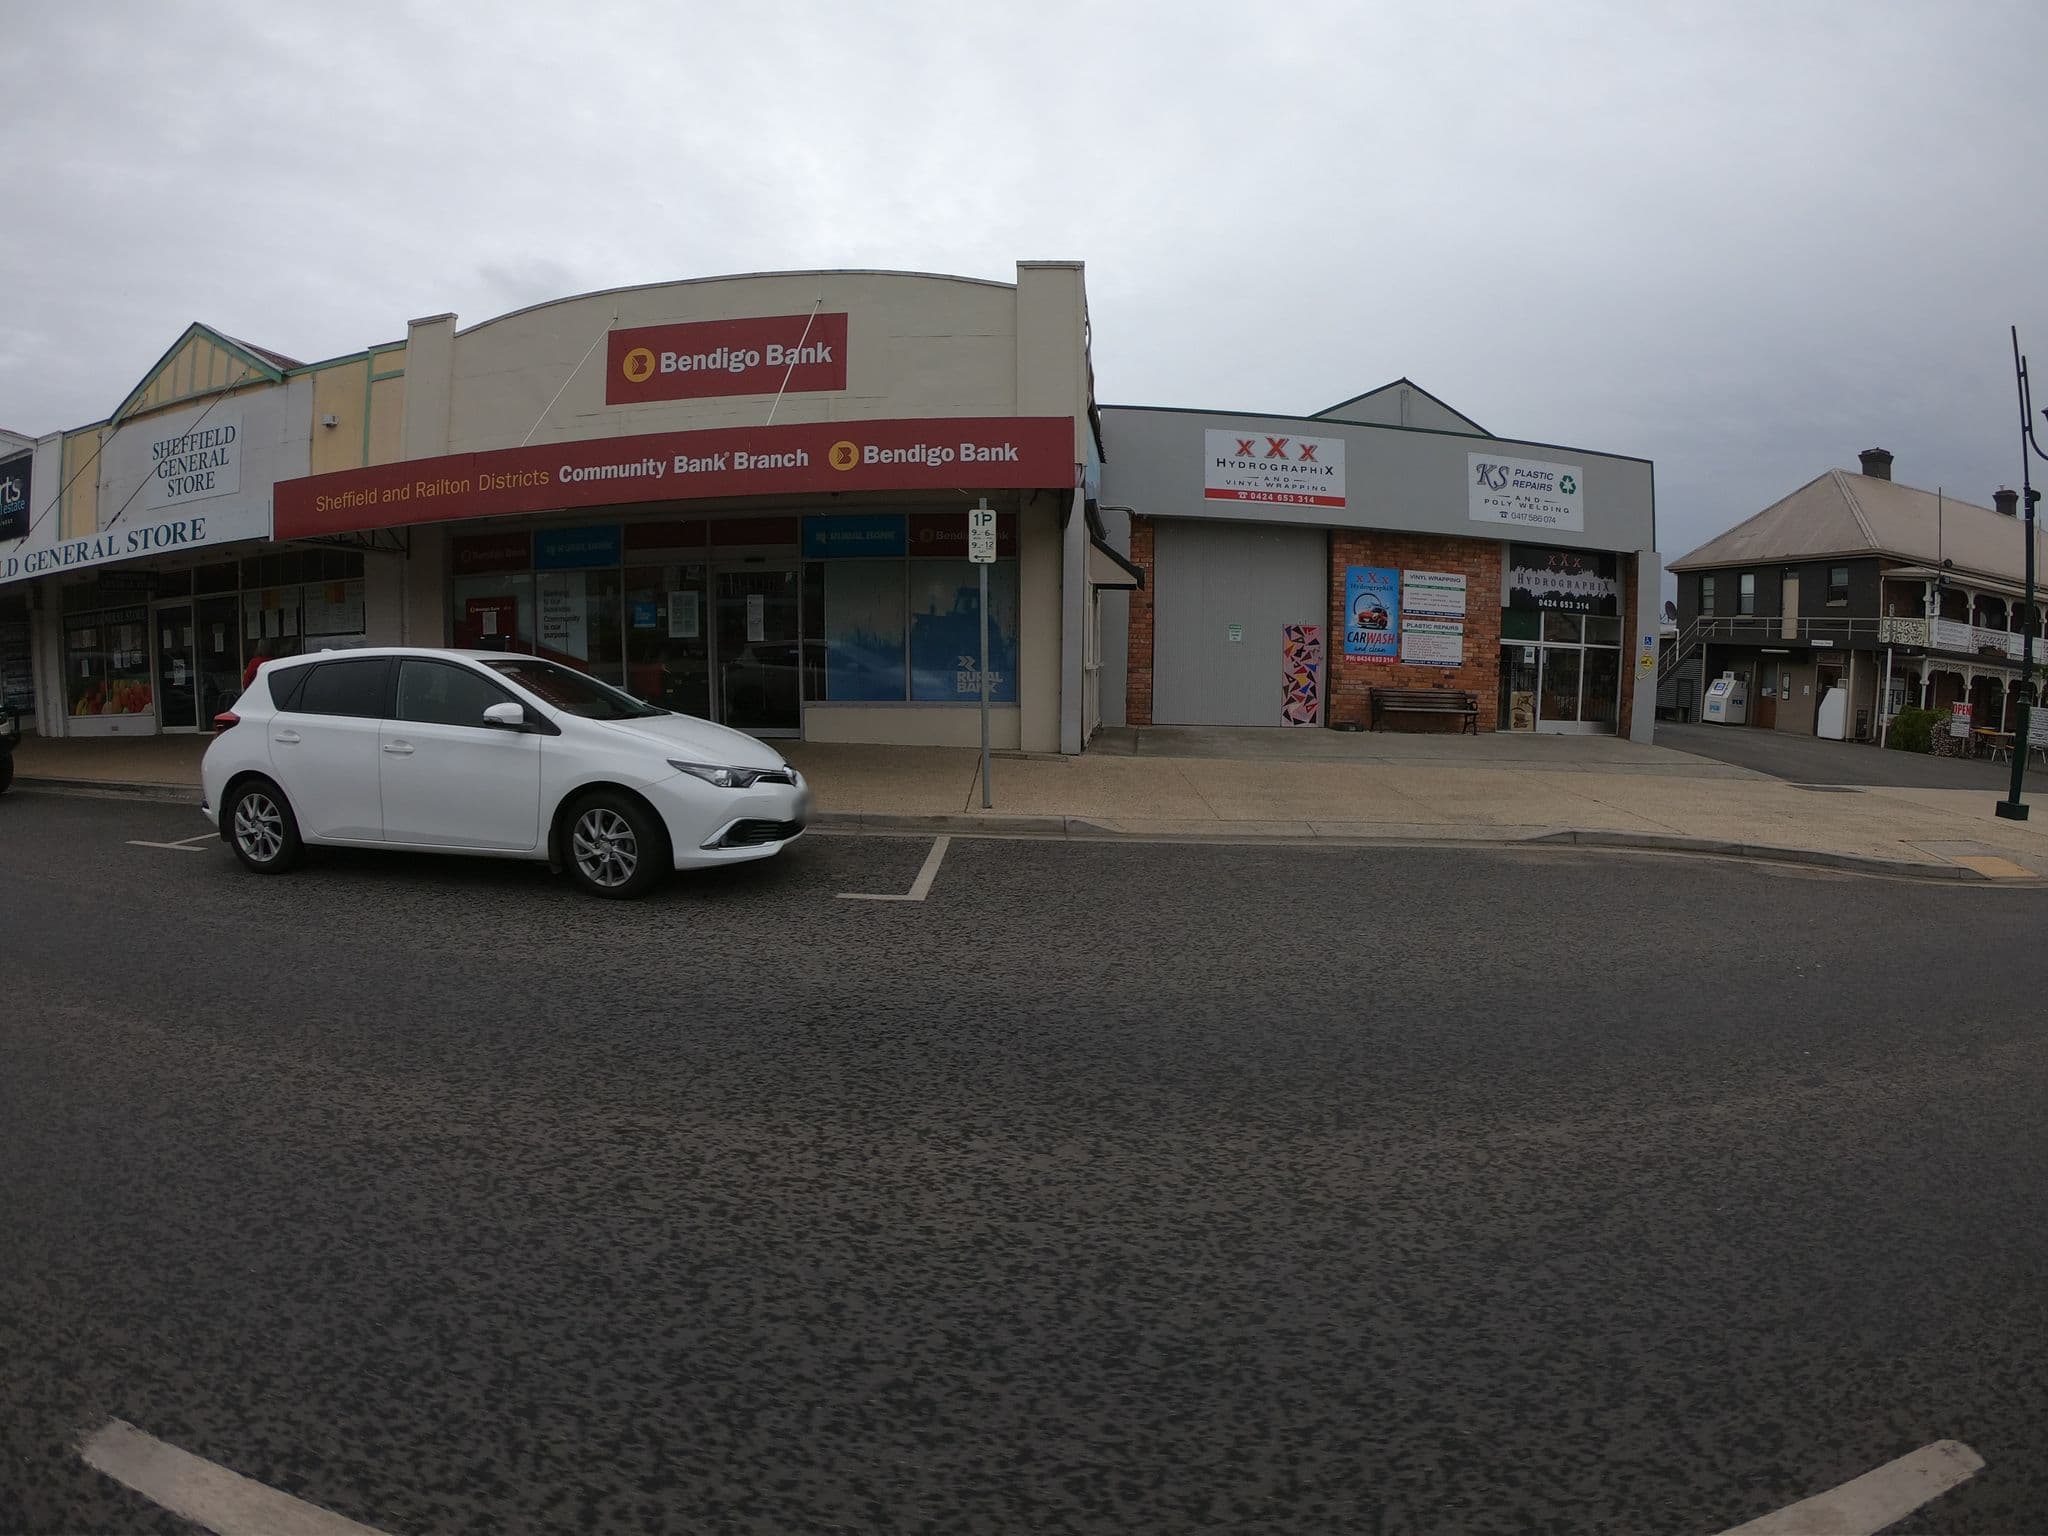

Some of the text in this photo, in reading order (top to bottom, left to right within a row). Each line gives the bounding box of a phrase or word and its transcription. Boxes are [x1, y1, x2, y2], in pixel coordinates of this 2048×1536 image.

[660, 342, 833, 373] Bendigo Bank
[152, 425, 236, 461] SHEFFIELD
[157, 447, 230, 479] GENERAL
[167, 471, 216, 498] STORE
[315, 487, 378, 513] Sheffield
[382, 485, 410, 503] and
[416, 477, 471, 499] Railton
[478, 469, 550, 491] Districts
[558, 457, 666, 484] Community
[734, 449, 809, 470] Branch
[864, 444, 955, 468] Bendigo
[960, 442, 1019, 463] Bank
[1476, 463, 1510, 491] KS
[1514, 468, 1554, 481] PLASTIC
[1226, 479, 1327, 492] VINYL WRAPPING
[1512, 479, 1553, 492] REPAIRS
[1484, 498, 1570, 514] POLY WELDING
[1515, 495, 1540, 503] AND
[974, 513, 993, 526] 1P
[24, 535, 120, 573] GENERAL
[127, 517, 206, 553] STORE
[1428, 575, 1461, 583] WRAPPING
